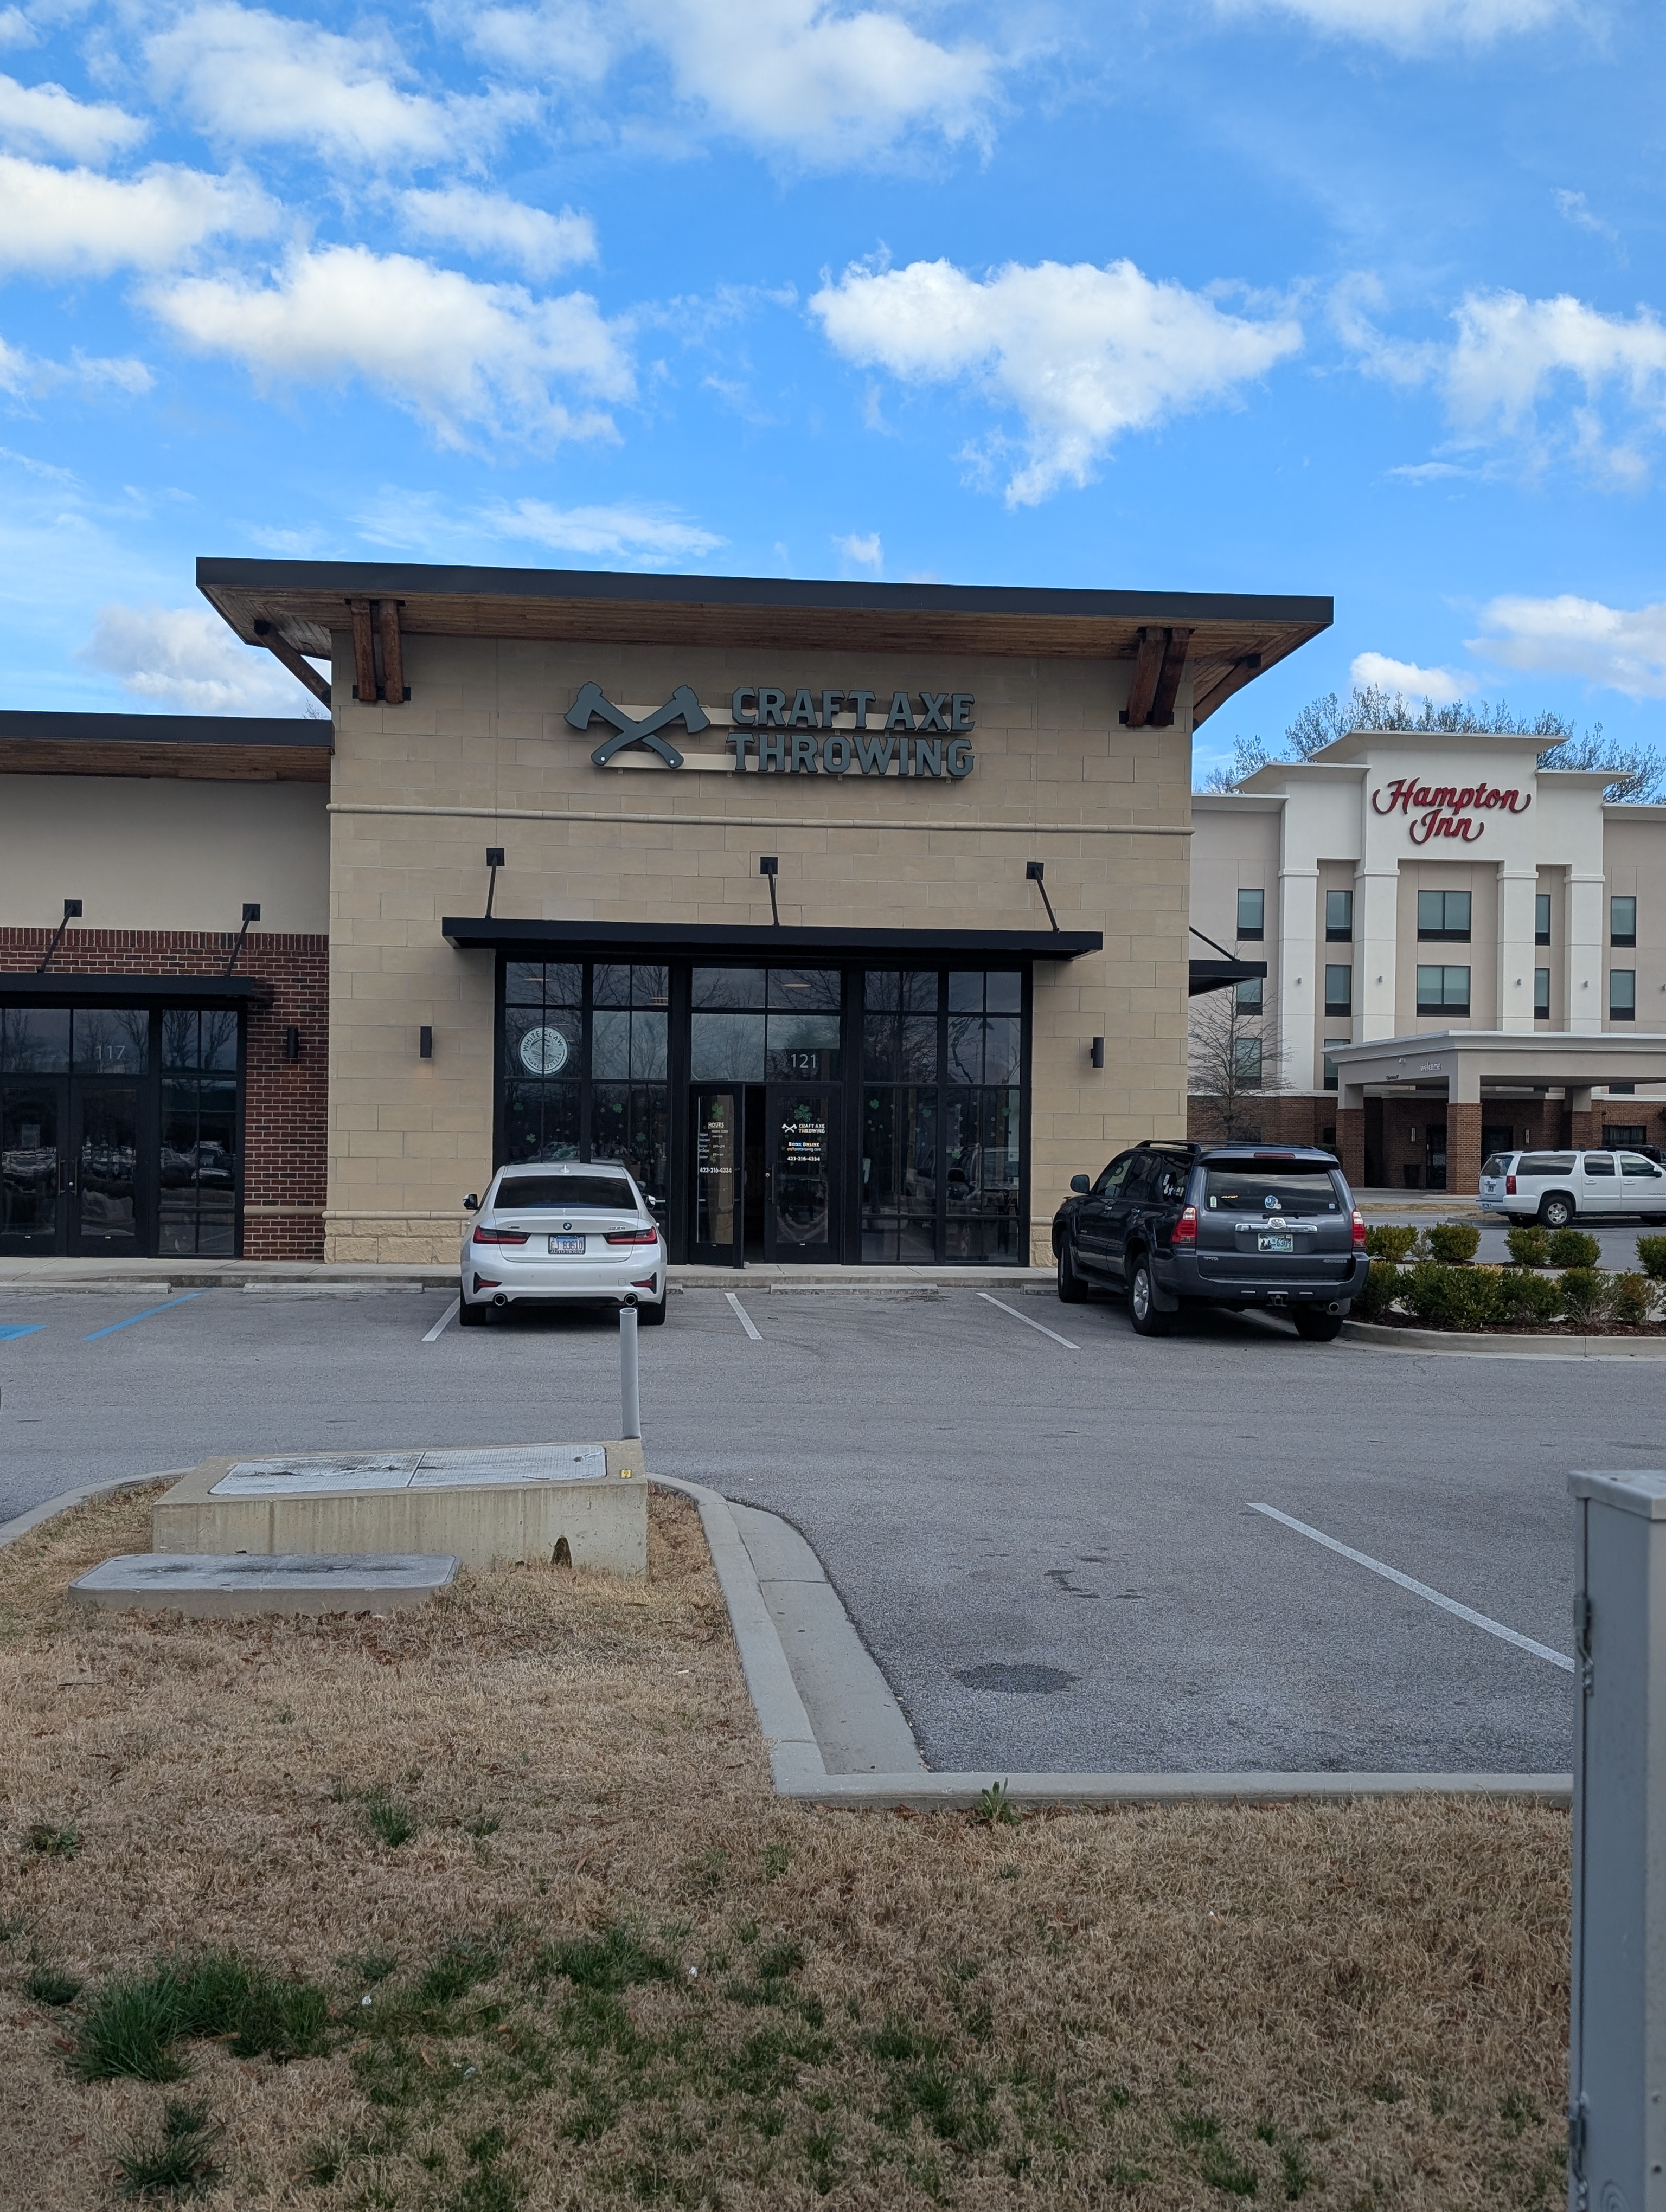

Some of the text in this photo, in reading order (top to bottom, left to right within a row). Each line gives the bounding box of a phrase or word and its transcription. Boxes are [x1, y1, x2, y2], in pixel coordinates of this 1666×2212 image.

[732, 687, 975, 731] CRAFT AXE
[726, 733, 975, 776] THROWING
[1372, 777, 1532, 815] Hampton
[1409, 808, 1485, 845] Inn
[95, 1045, 125, 1059] 117
[523, 1030, 564, 1052] WHITE CLAW
[791, 1054, 816, 1068] 121
[562, 1240, 583, 1250] 83610
